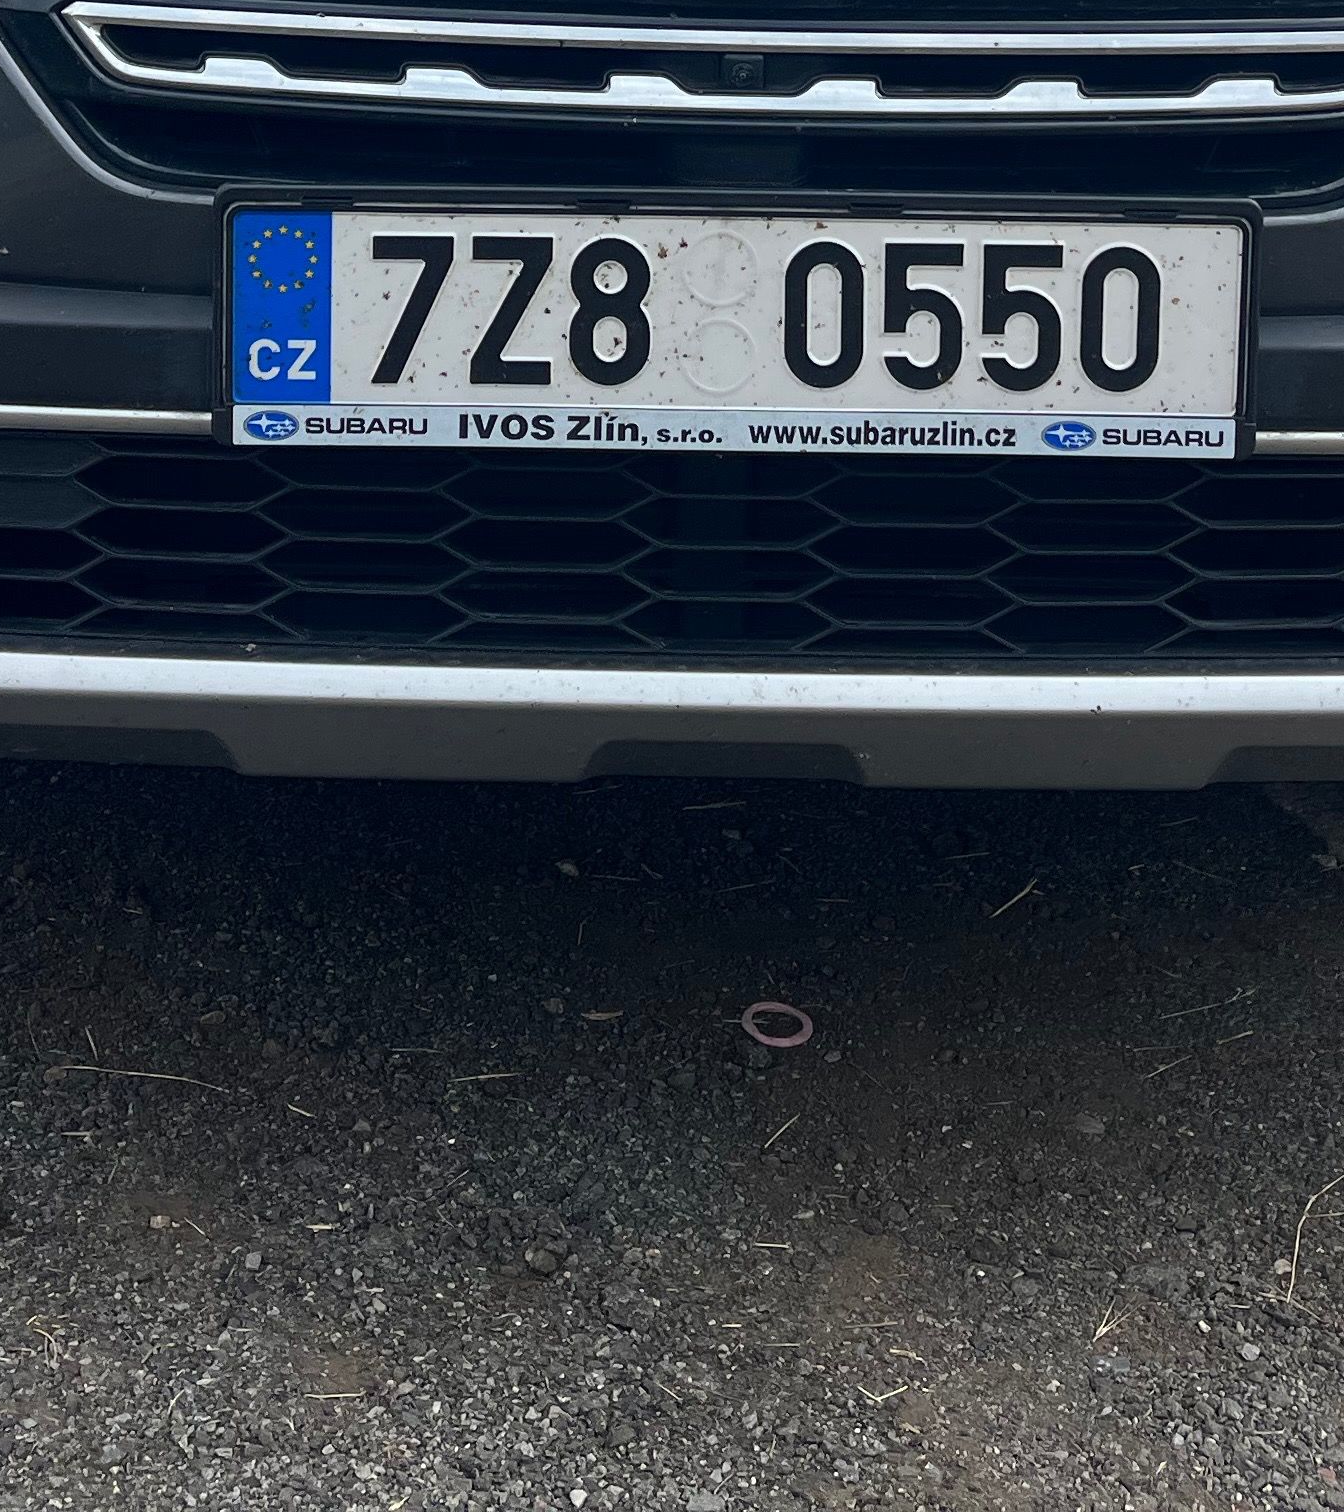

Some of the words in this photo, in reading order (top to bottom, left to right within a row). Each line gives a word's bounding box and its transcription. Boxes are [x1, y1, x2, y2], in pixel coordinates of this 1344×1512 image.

[370, 234, 652, 386] 7Z8
[783, 240, 1162, 392] 0550
[247, 338, 318, 382] CZ
[304, 417, 429, 436] SUBARU
[458, 413, 555, 441] IVOS
[566, 414, 649, 447] Zlín,
[656, 425, 723, 445] s.r.o.
[749, 421, 1017, 448] www.subaruzlin.cz
[1102, 428, 1225, 448] SUBARU
